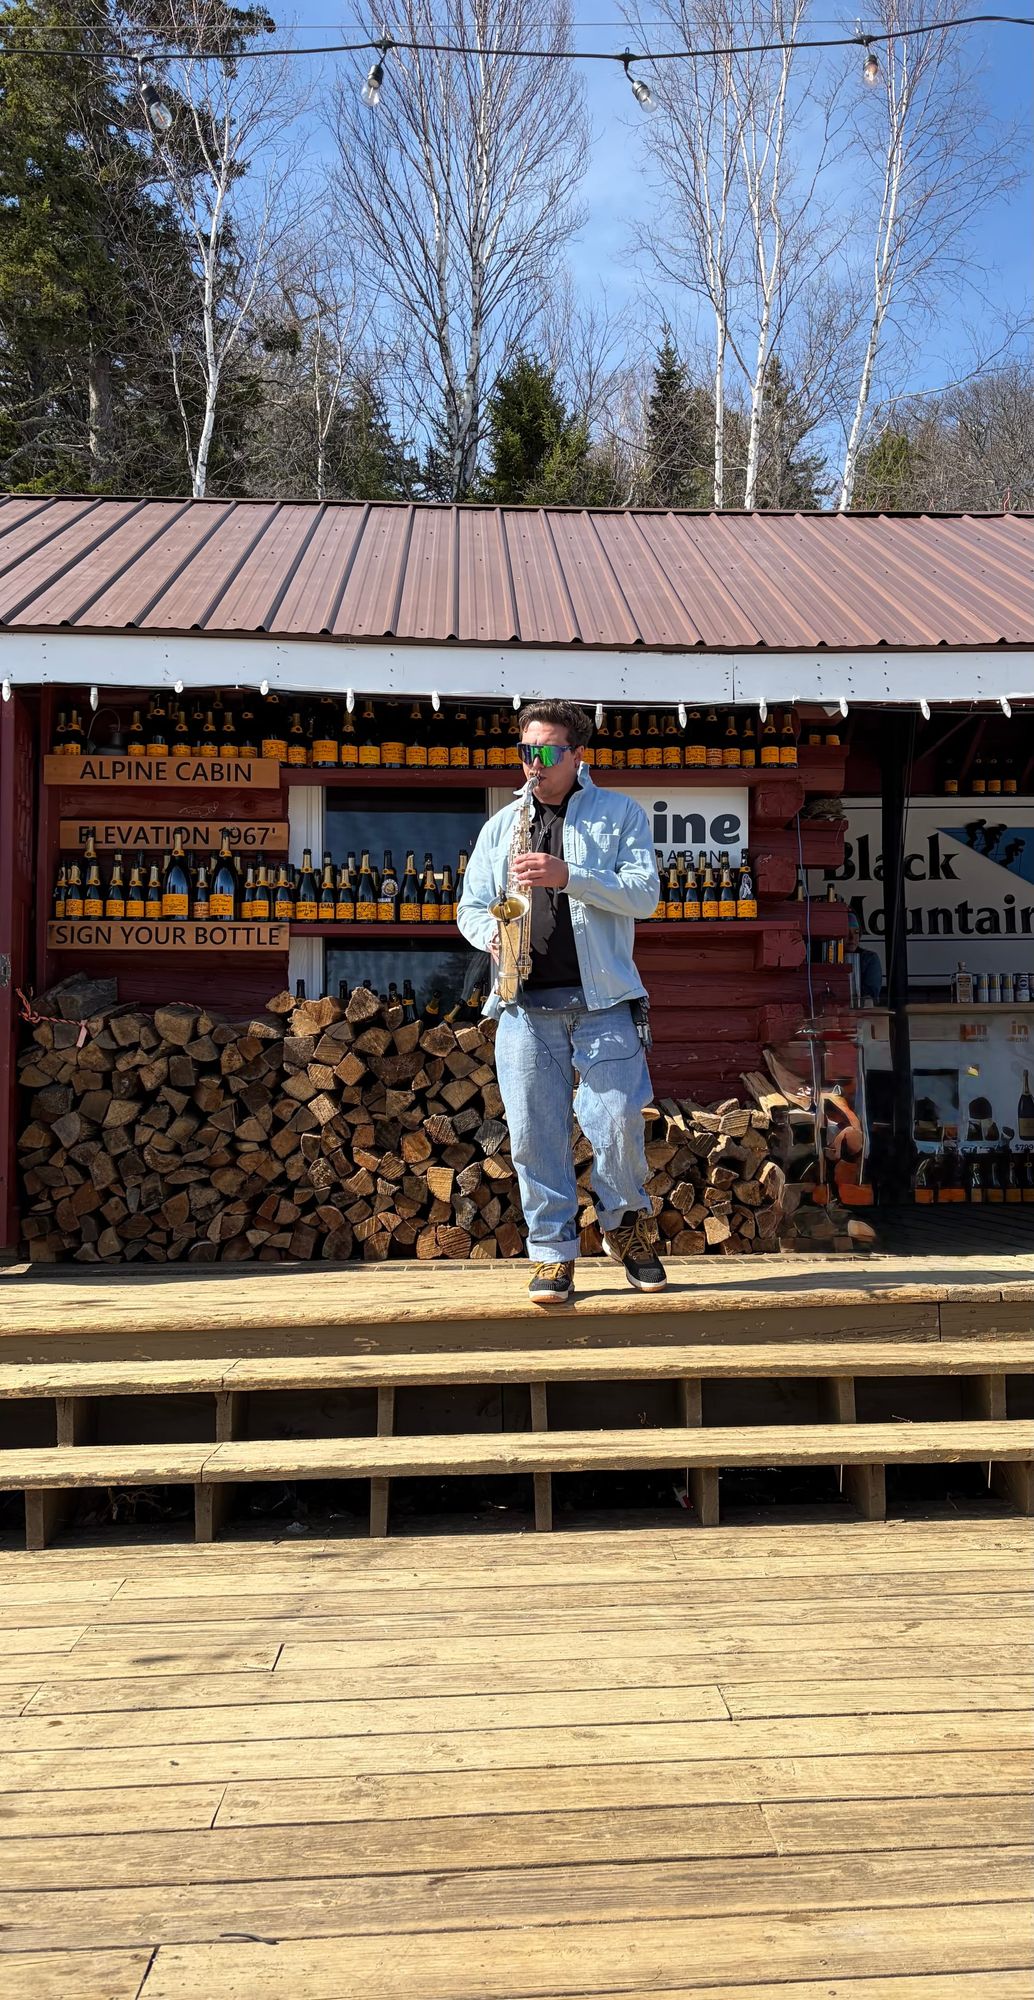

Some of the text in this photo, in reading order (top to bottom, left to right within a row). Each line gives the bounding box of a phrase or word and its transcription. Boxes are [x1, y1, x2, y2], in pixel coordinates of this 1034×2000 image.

[79, 760, 253, 782] ALPINE CABIN
[654, 801, 741, 845] ine
[78, 825, 276, 845] ELEVATION 1967'
[655, 849, 722, 864] ABN
[55, 925, 280, 946] SIGN YOUR BOTTLE
